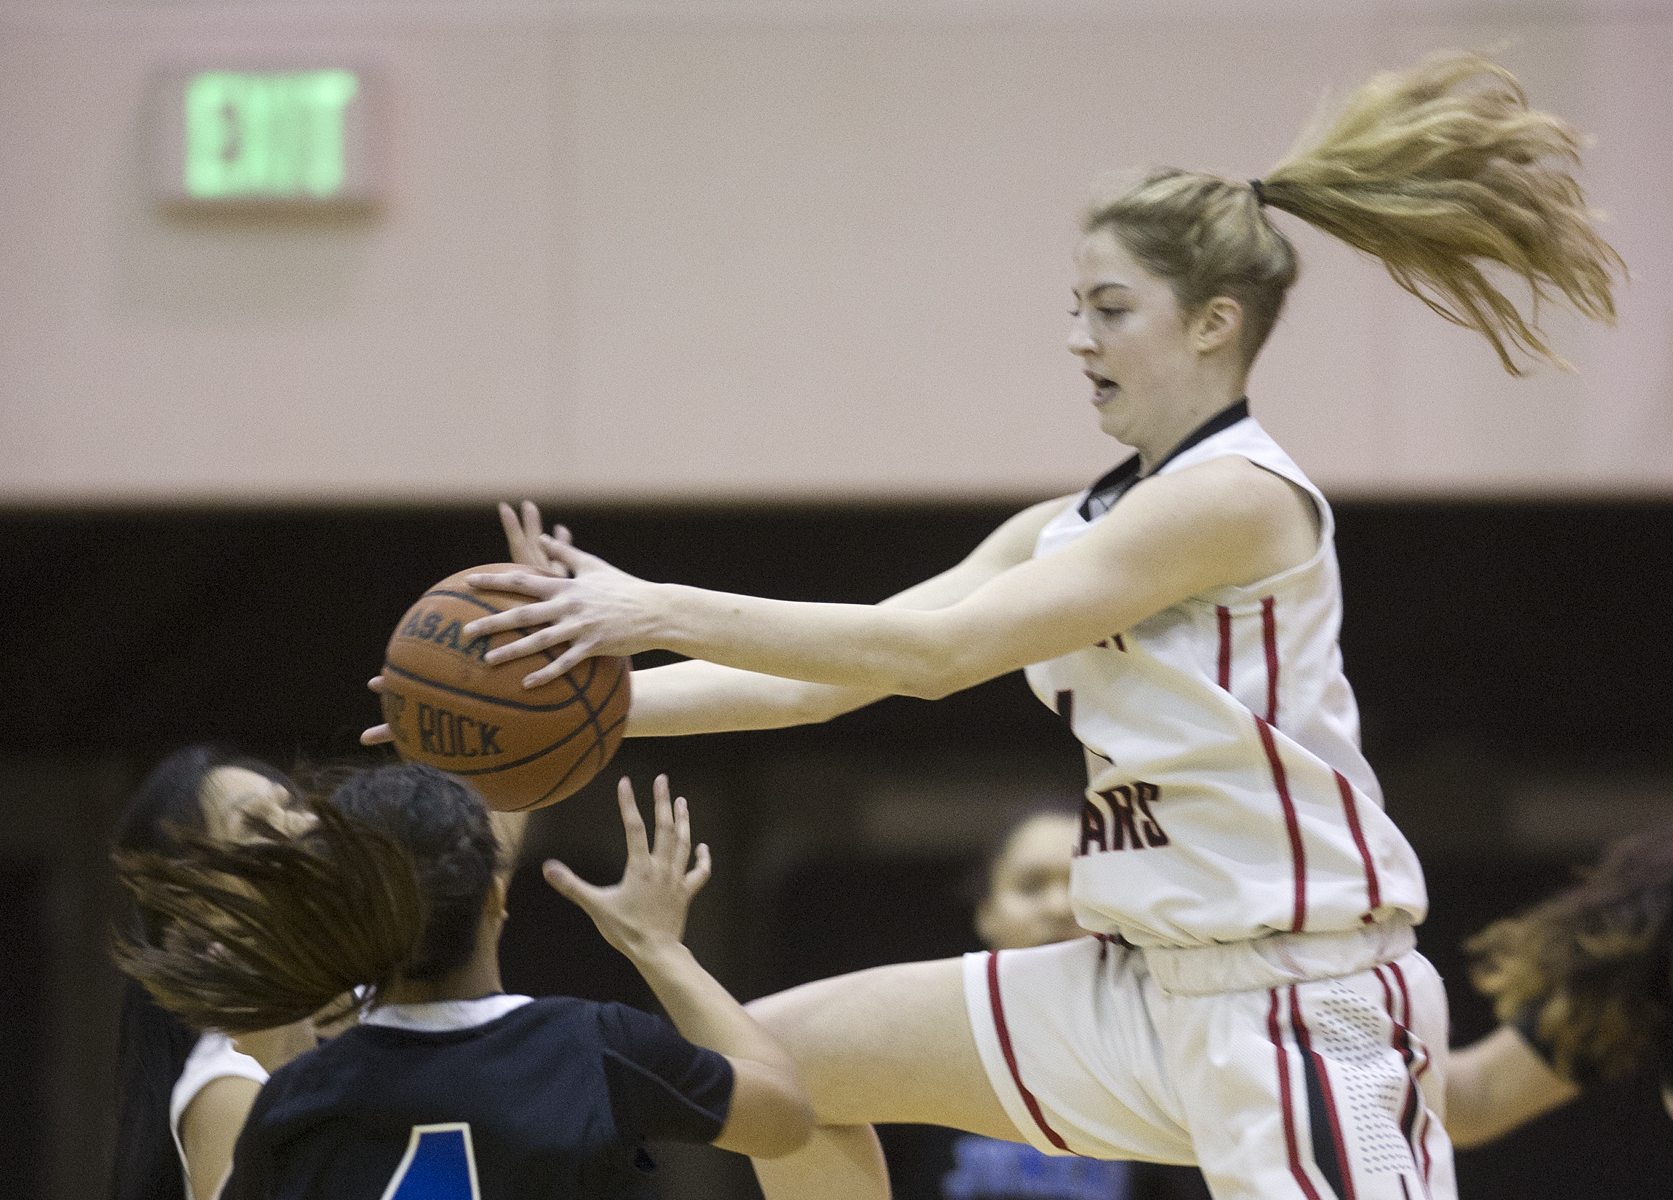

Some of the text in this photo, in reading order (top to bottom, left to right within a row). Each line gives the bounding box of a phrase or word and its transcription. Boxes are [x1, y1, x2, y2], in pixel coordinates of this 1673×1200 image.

[184, 69, 358, 199] EXIT
[417, 702, 503, 757] ROCK
[1074, 781, 1169, 857] ARS
